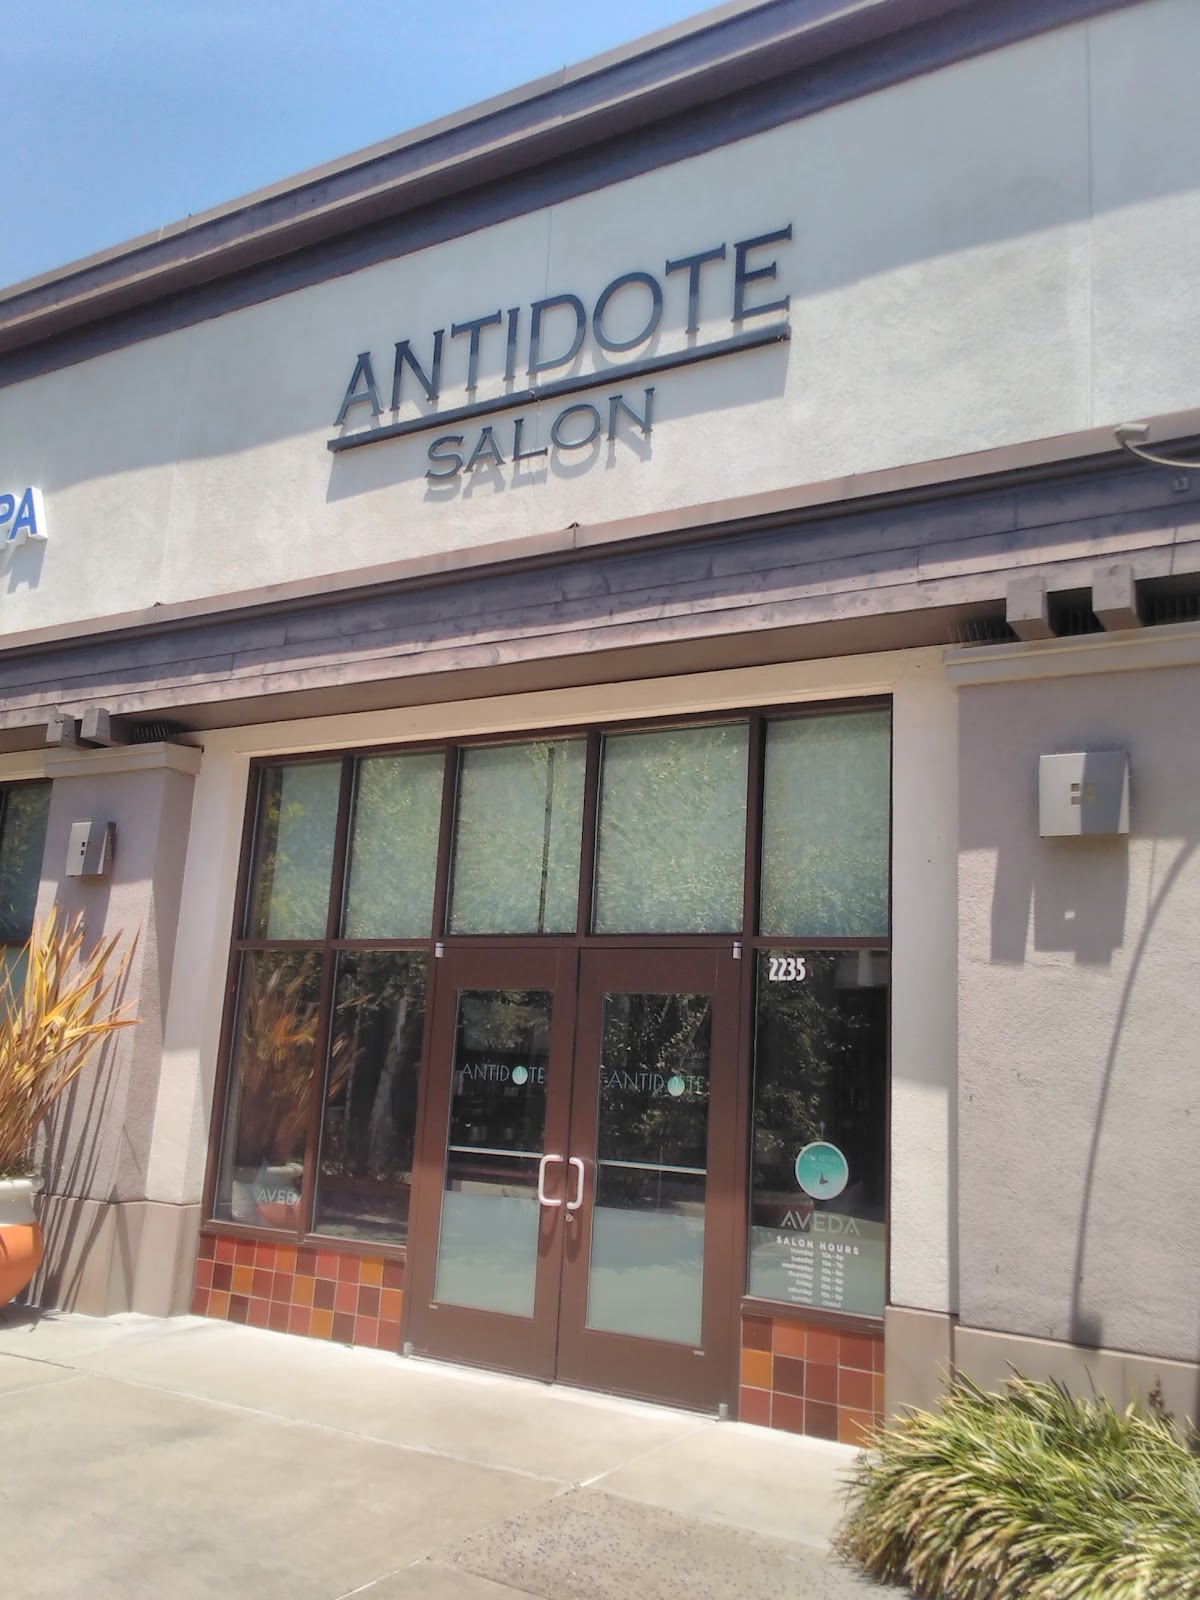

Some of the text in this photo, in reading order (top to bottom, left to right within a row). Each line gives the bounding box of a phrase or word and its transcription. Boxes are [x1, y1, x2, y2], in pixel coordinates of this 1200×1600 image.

[333, 223, 793, 427] ANTIDOTE
[425, 387, 655, 480] SALON
[768, 957, 806, 982] 2235
[780, 1209, 860, 1236] AVEDA
[776, 1235, 860, 1256] SALON HOURS
